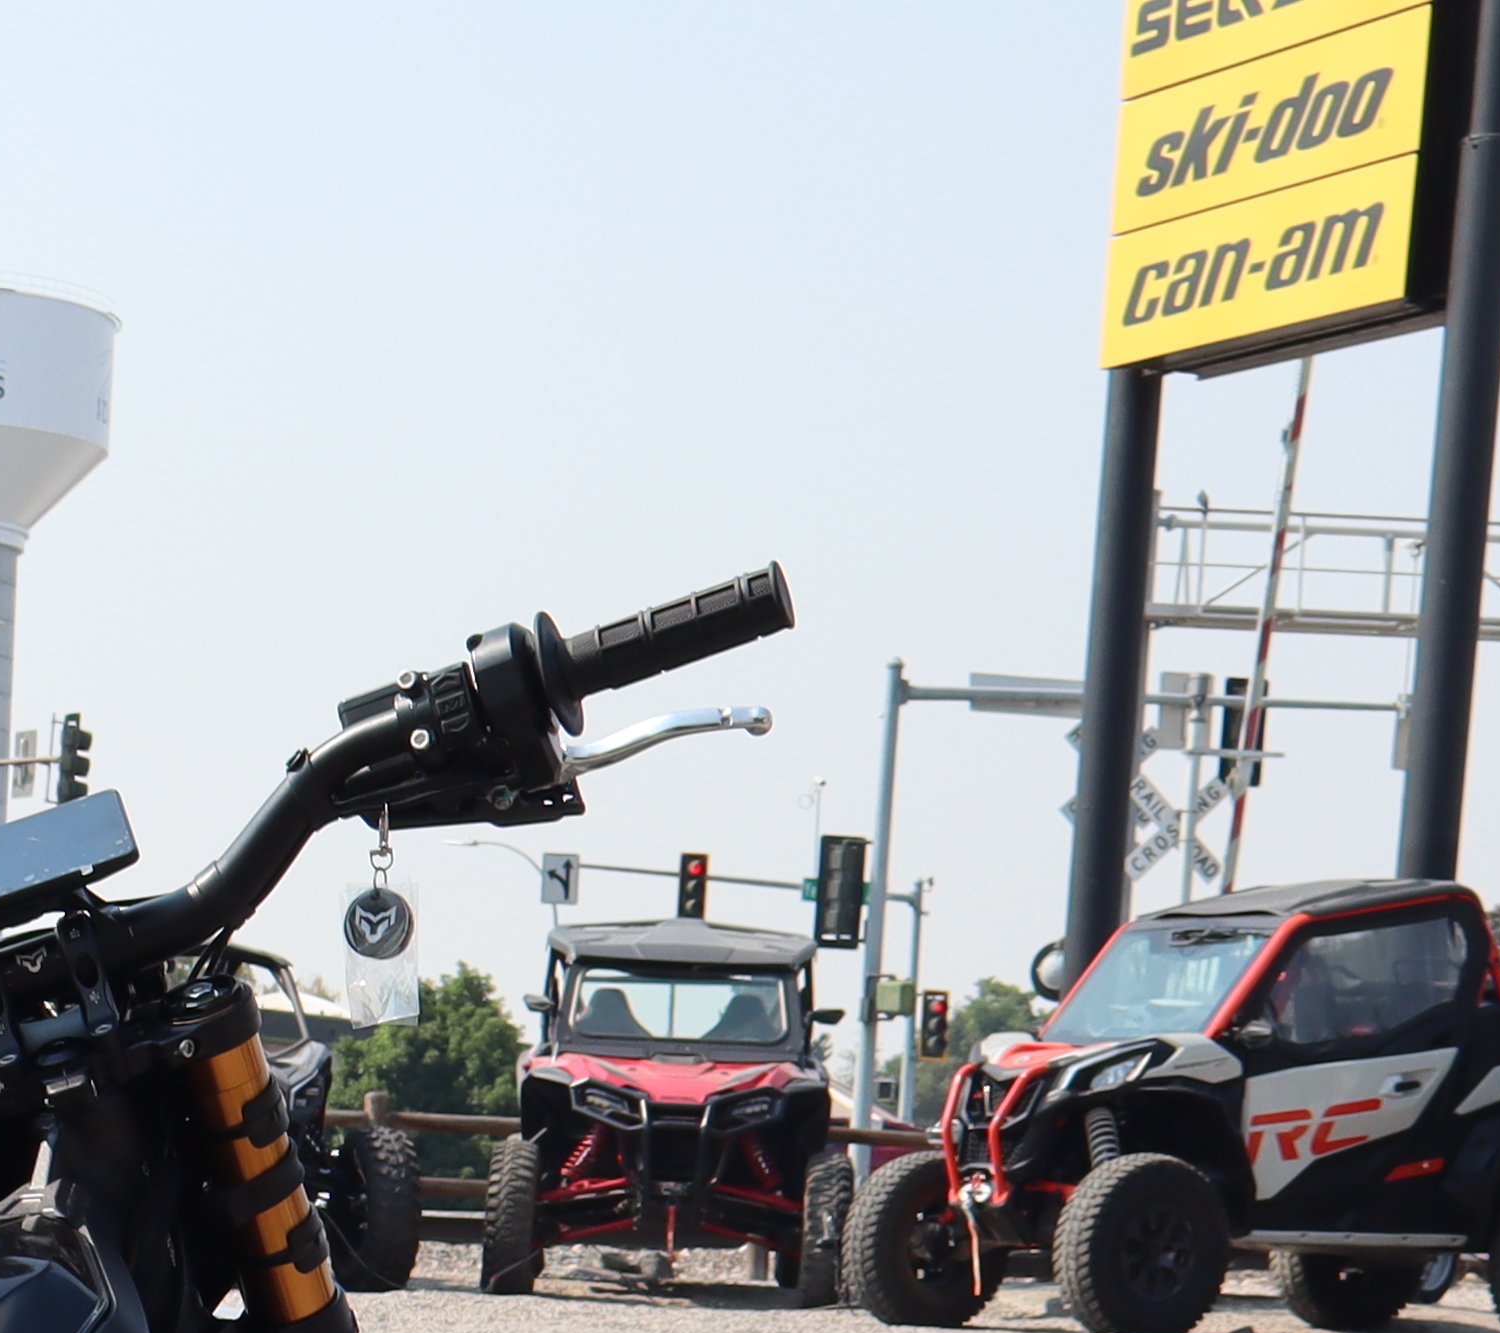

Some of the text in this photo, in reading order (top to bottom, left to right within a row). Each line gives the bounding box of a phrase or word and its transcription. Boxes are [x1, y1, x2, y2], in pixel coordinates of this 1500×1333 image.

[1135, 66, 1394, 198] ski-doo
[1122, 200, 1385, 328] can-am
[1130, 779, 1168, 821] RAIL
